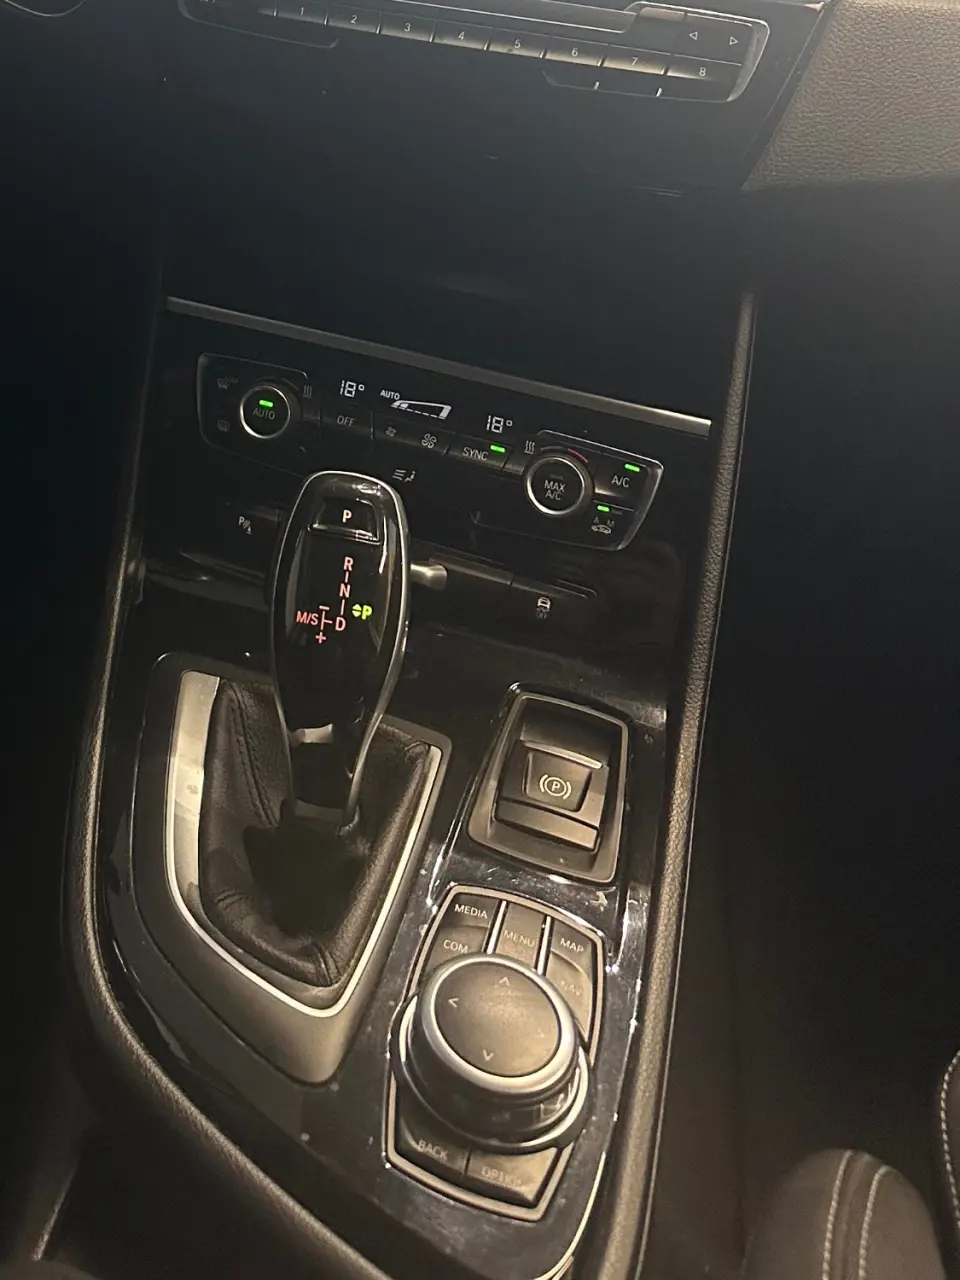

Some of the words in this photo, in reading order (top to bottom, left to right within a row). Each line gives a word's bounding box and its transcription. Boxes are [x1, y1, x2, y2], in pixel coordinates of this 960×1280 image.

[300, 6, 305, 16] 1
[350, 14, 358, 24] 2
[404, 22, 411, 32] 3
[457, 31, 465, 40] 4
[514, 38, 521, 49] 5
[571, 47, 579, 57] 6
[631, 57, 638, 66] 7
[699, 67, 707, 77] 8
[380, 389, 400, 401] AUTO
[252, 406, 276, 420] AUTO
[336, 415, 356, 428] OFF
[462, 446, 489, 461] SYNC
[544, 479, 566, 493] MAX
[611, 475, 631, 488] A/C
[544, 491, 562, 501] A/C
[342, 509, 352, 523] P
[343, 556, 353, 571] R
[339, 583, 350, 598] N
[296, 610, 319, 625] M/S
[335, 616, 346, 631] D
[454, 904, 488, 920] MEDIA
[503, 929, 535, 947] MENU
[559, 937, 585, 953] MAP
[443, 939, 469, 954] COM
[560, 980, 583, 997] NAV
[417, 1139, 448, 1161] BACK
